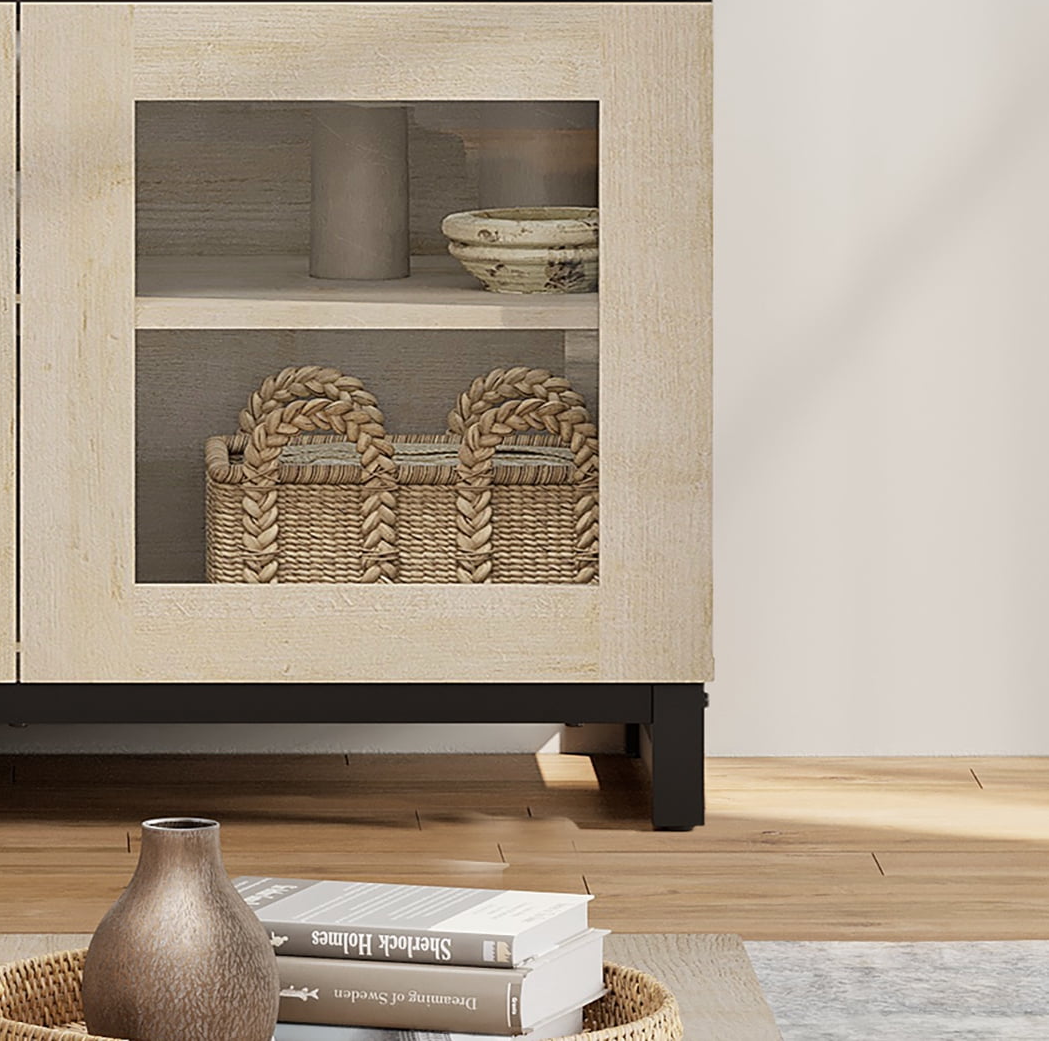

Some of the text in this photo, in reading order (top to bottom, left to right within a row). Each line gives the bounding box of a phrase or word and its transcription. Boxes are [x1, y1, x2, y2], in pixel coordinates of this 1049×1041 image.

[311, 929, 452, 961] Sherlock Holmes
[333, 988, 478, 1010] Dreaming of Sweden
